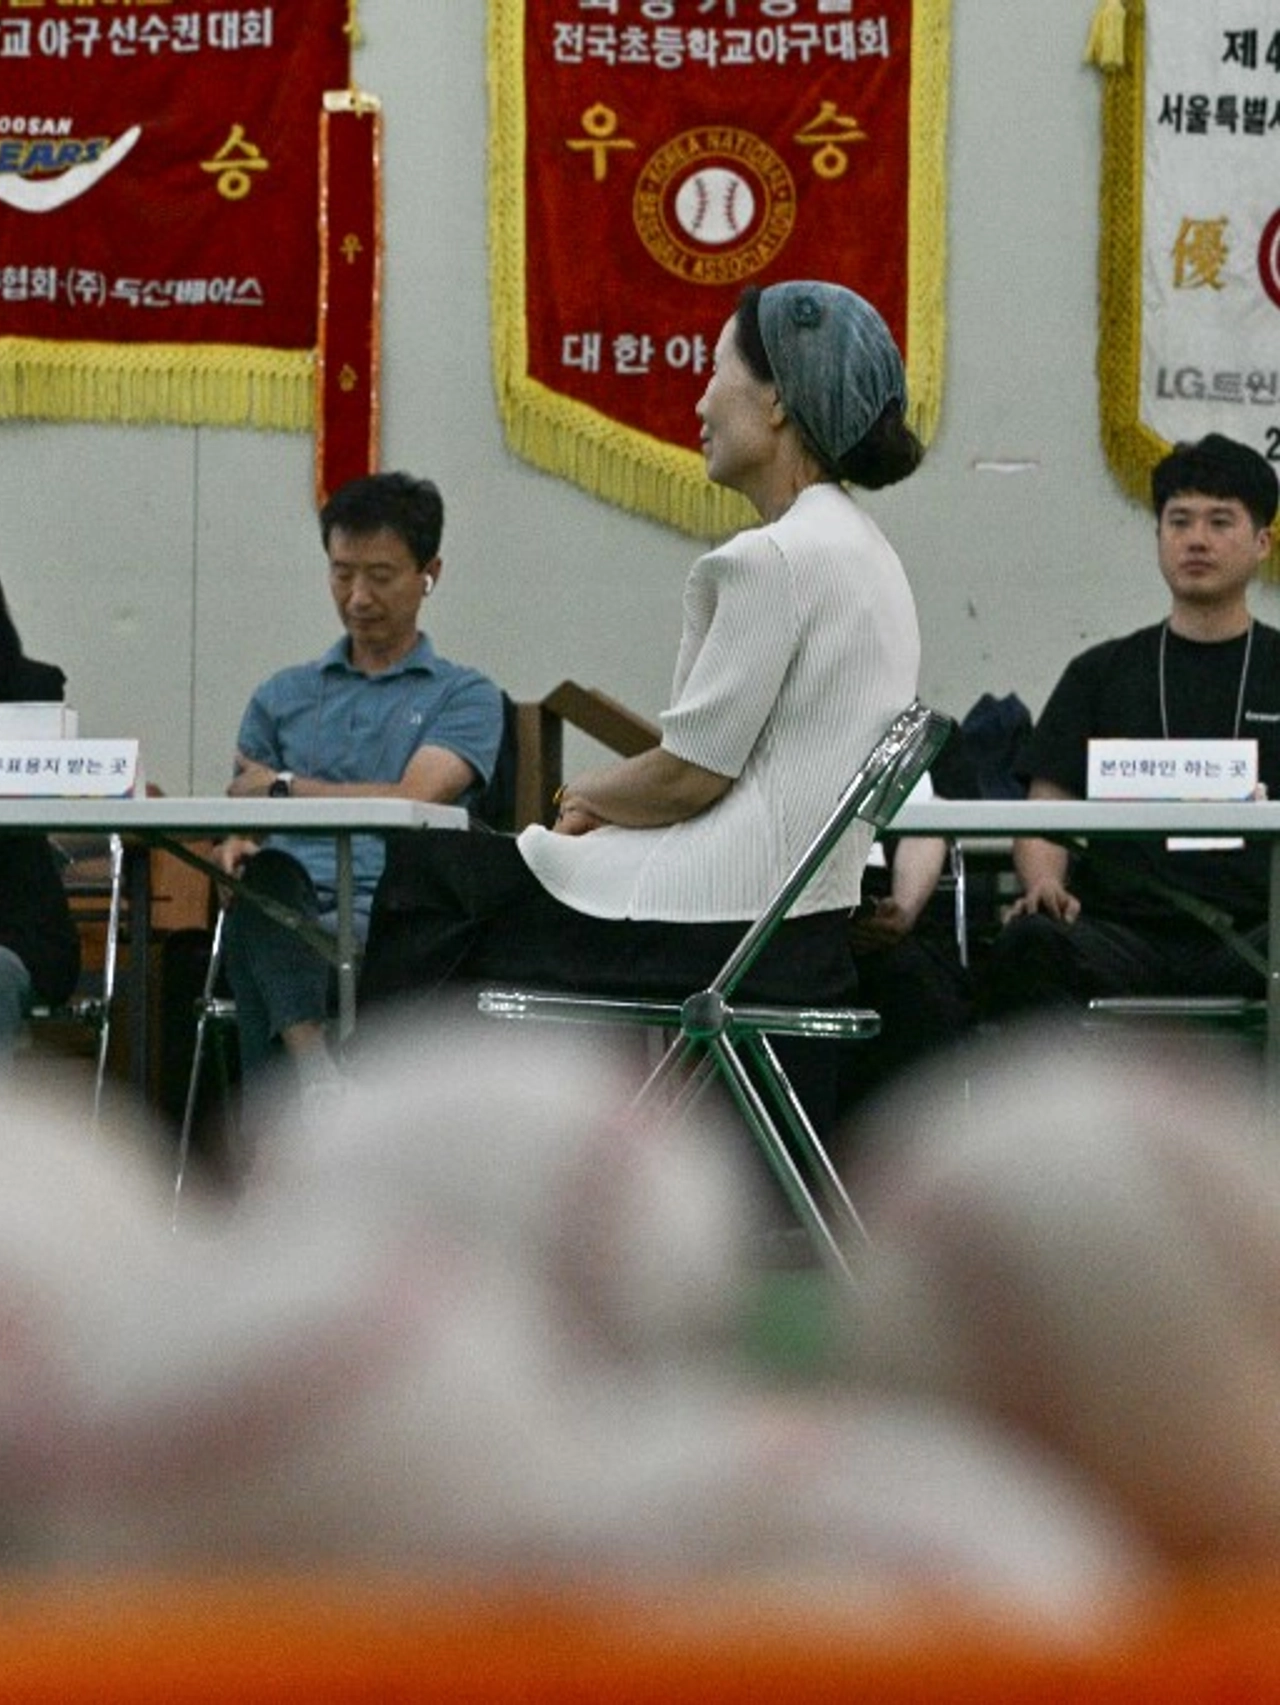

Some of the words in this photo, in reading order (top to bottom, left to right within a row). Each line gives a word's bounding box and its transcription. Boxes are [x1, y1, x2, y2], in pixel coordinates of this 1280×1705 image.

[37, 16, 101, 57] 야구
[107, 13, 200, 55] 선수권
[207, 8, 273, 50] 대회
[553, 18, 890, 68] 전국초등학교야구대회
[200, 124, 268, 200] 승
[566, 102, 636, 182] 우
[794, 101, 869, 179] 승
[67, 756, 103, 774] 받는
[110, 757, 128, 774] 곳
[1100, 759, 1176, 777] 본인확인
[1184, 759, 1221, 777] 하는
[1228, 759, 1247, 777] 곳
